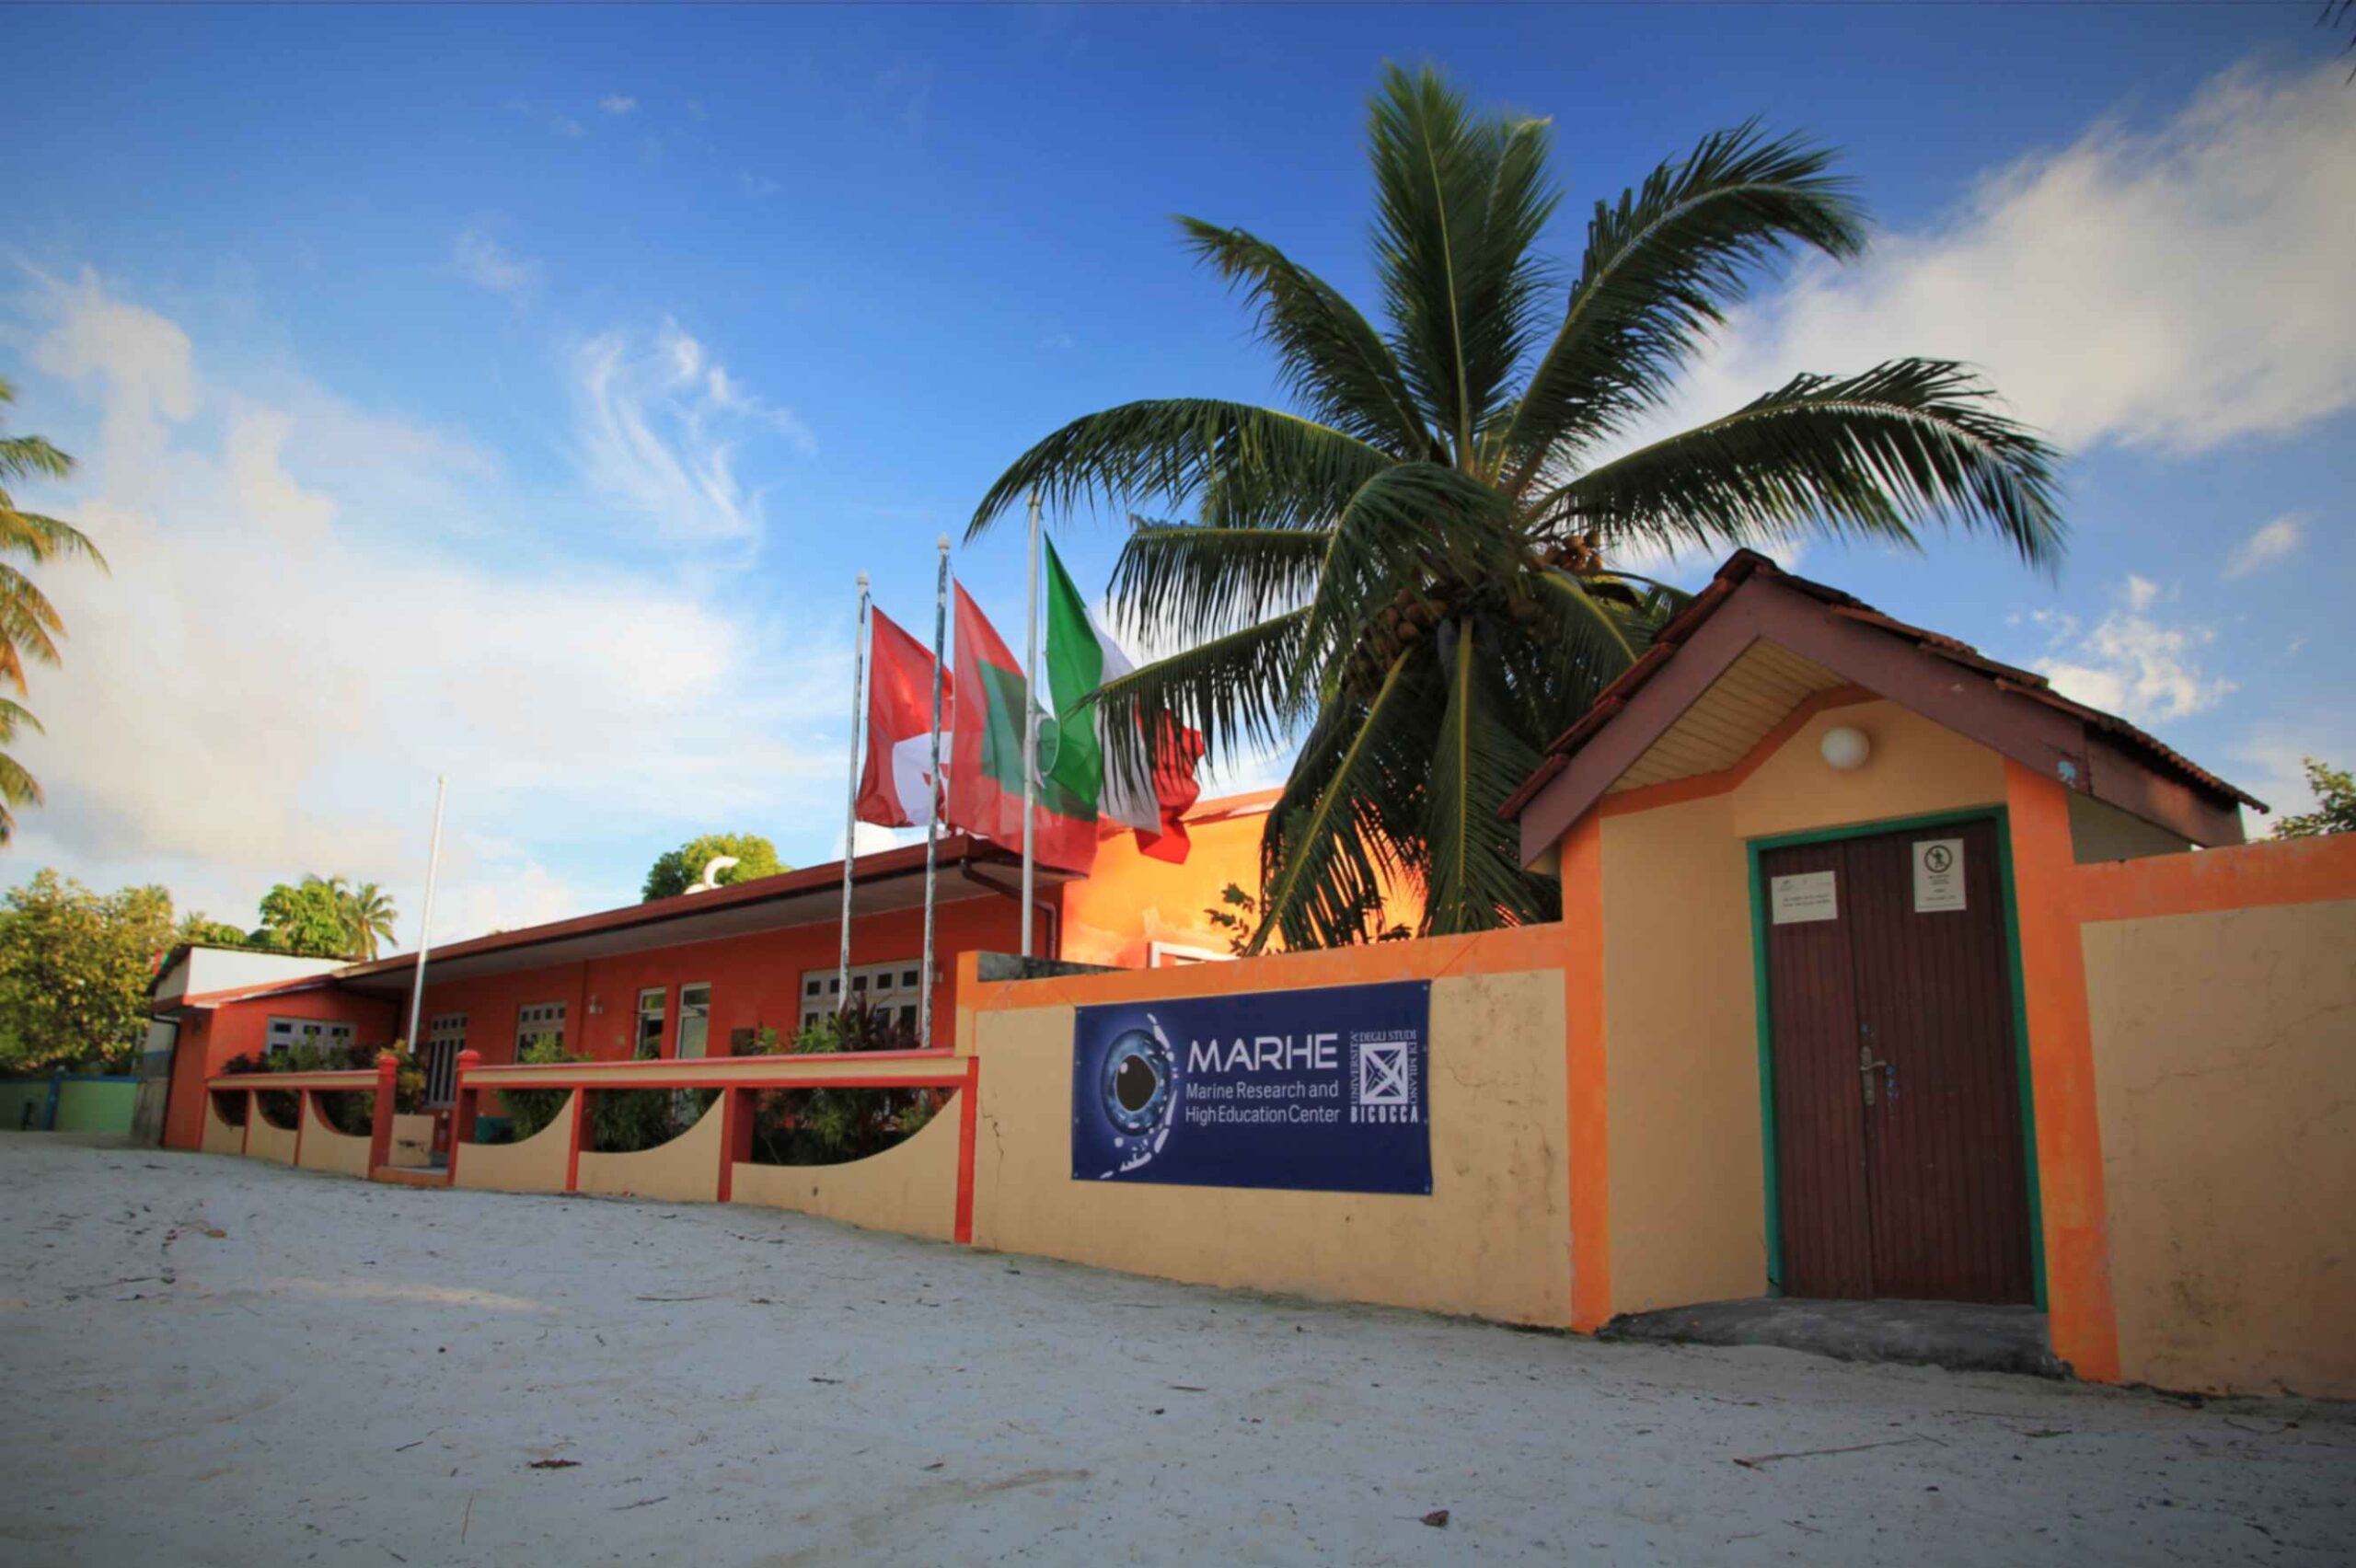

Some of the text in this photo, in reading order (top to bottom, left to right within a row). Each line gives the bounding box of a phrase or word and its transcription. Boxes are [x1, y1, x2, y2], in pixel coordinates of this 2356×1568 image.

[1360, 1030, 1416, 1042] DEGLI STUDI
[1186, 1033, 1339, 1073] MARHE
[1408, 1042, 1418, 1104] DI MILANO
[1186, 1078, 1339, 1100] Marine Research and
[1185, 1104, 1340, 1126] High Education Center
[1350, 1105, 1418, 1124] BICOCCA
